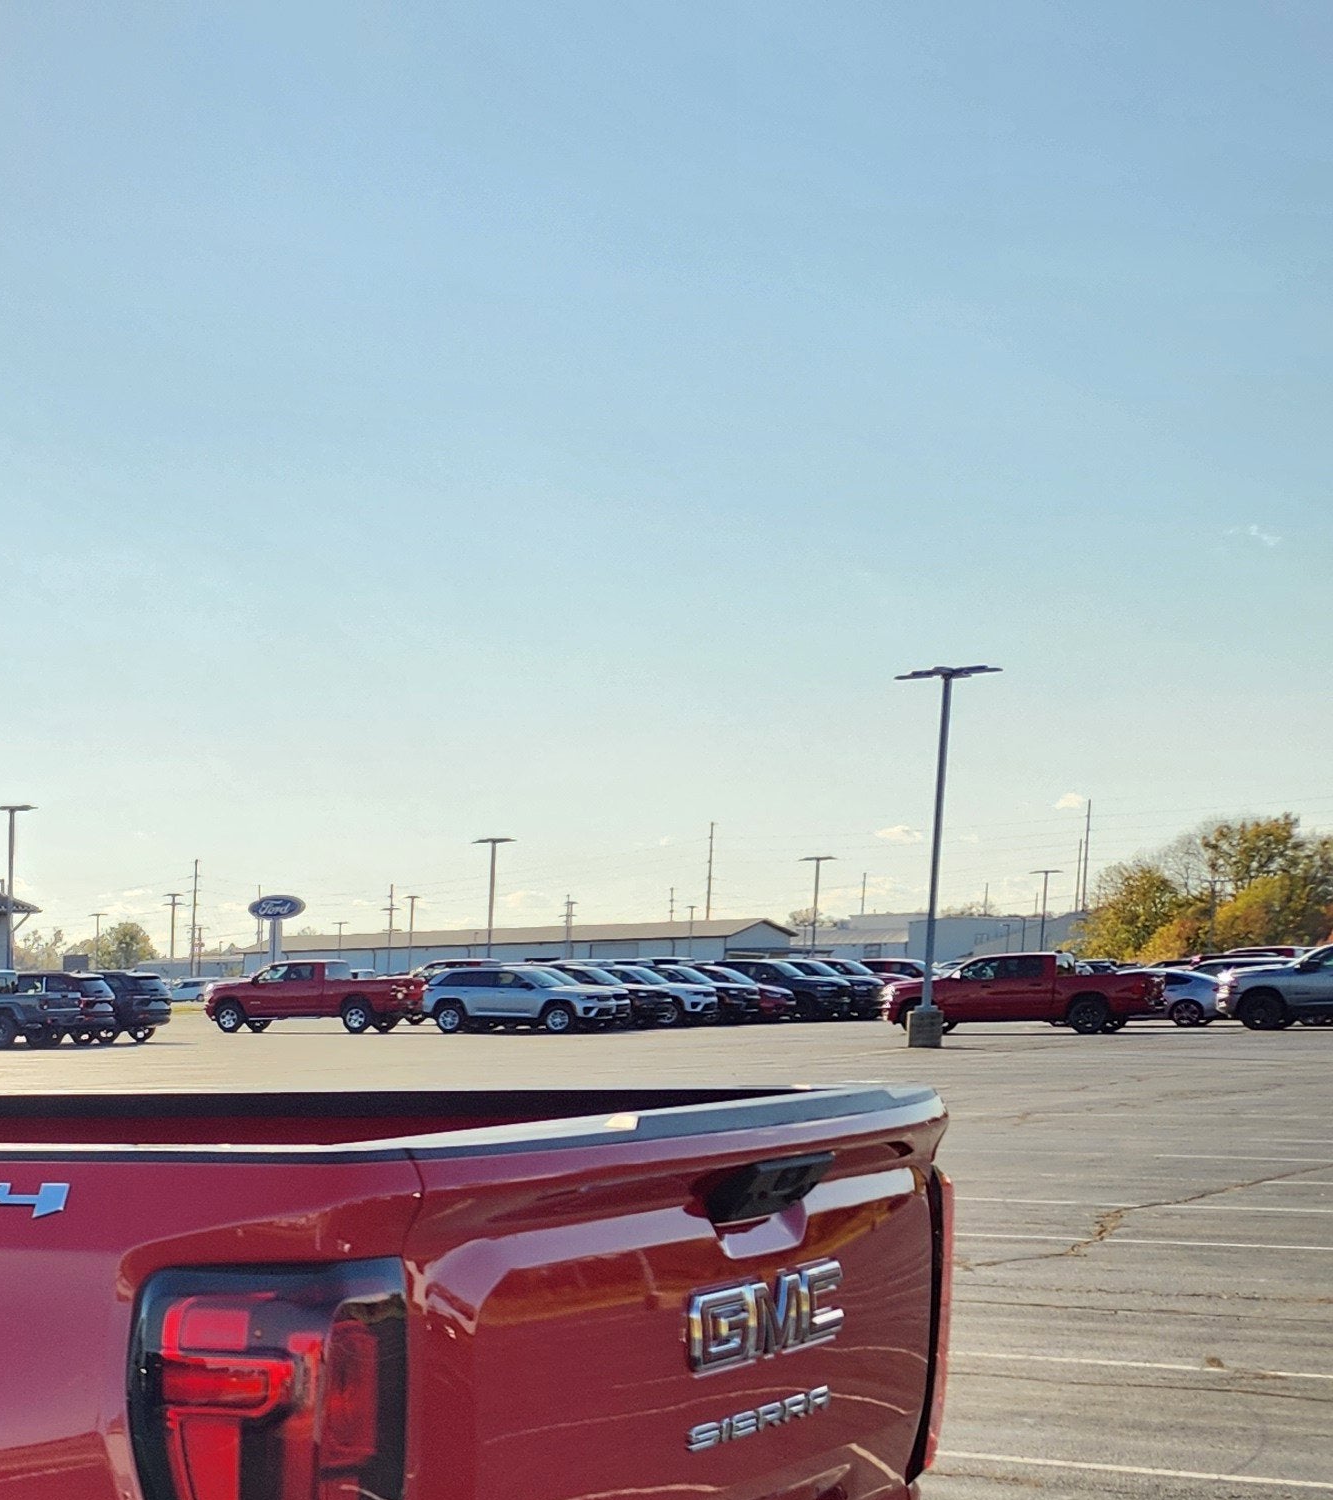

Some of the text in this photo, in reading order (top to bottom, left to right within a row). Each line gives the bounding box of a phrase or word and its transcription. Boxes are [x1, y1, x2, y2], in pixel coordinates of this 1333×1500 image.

[258, 900, 291, 915] Ford
[689, 1260, 844, 1375] GMC
[687, 1385, 831, 1452] SIERRA
